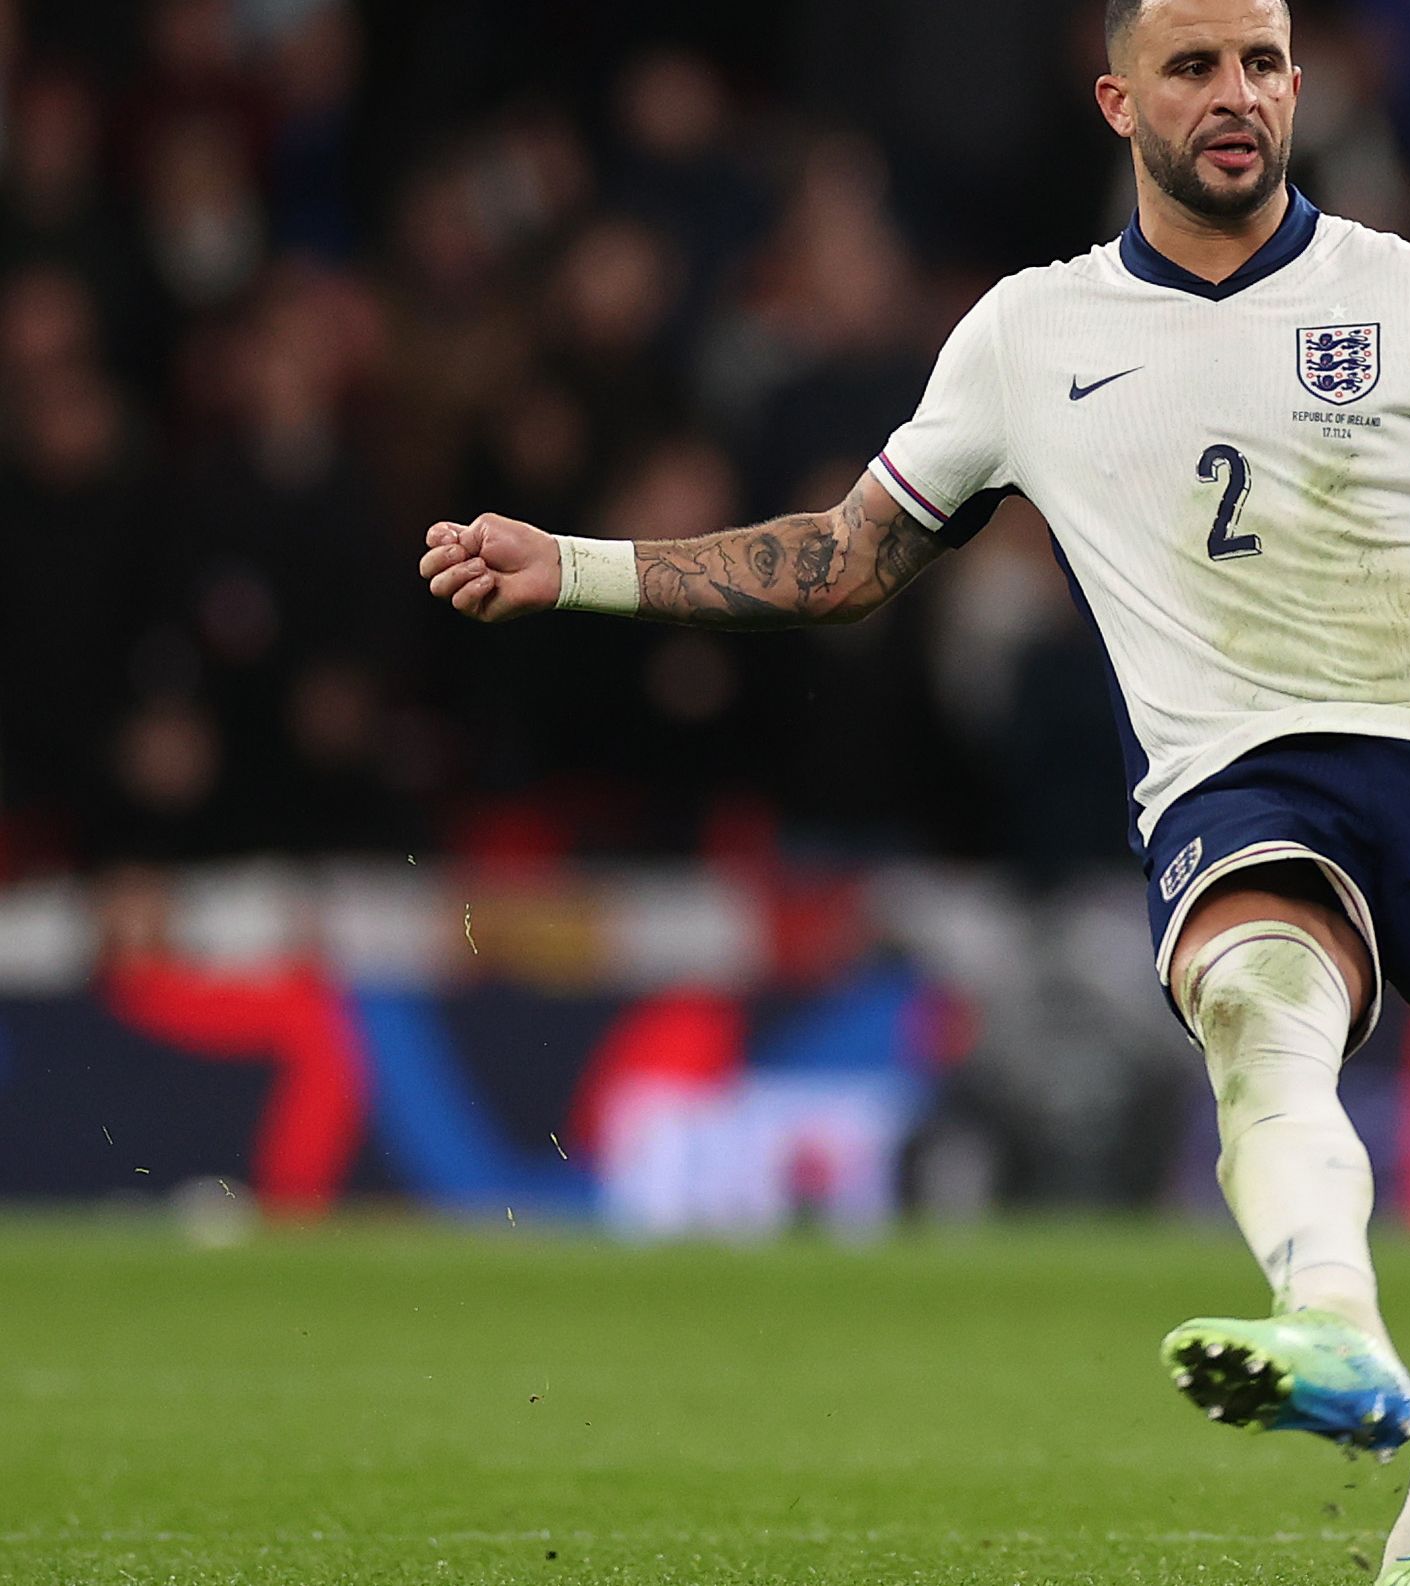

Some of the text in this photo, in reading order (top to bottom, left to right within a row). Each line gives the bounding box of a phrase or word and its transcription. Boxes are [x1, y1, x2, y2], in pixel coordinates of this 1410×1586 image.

[1292, 411, 1381, 427] REPUBLIC OF IRELAND
[1322, 427, 1352, 439] 17.11.24
[1196, 444, 1263, 561] 2
